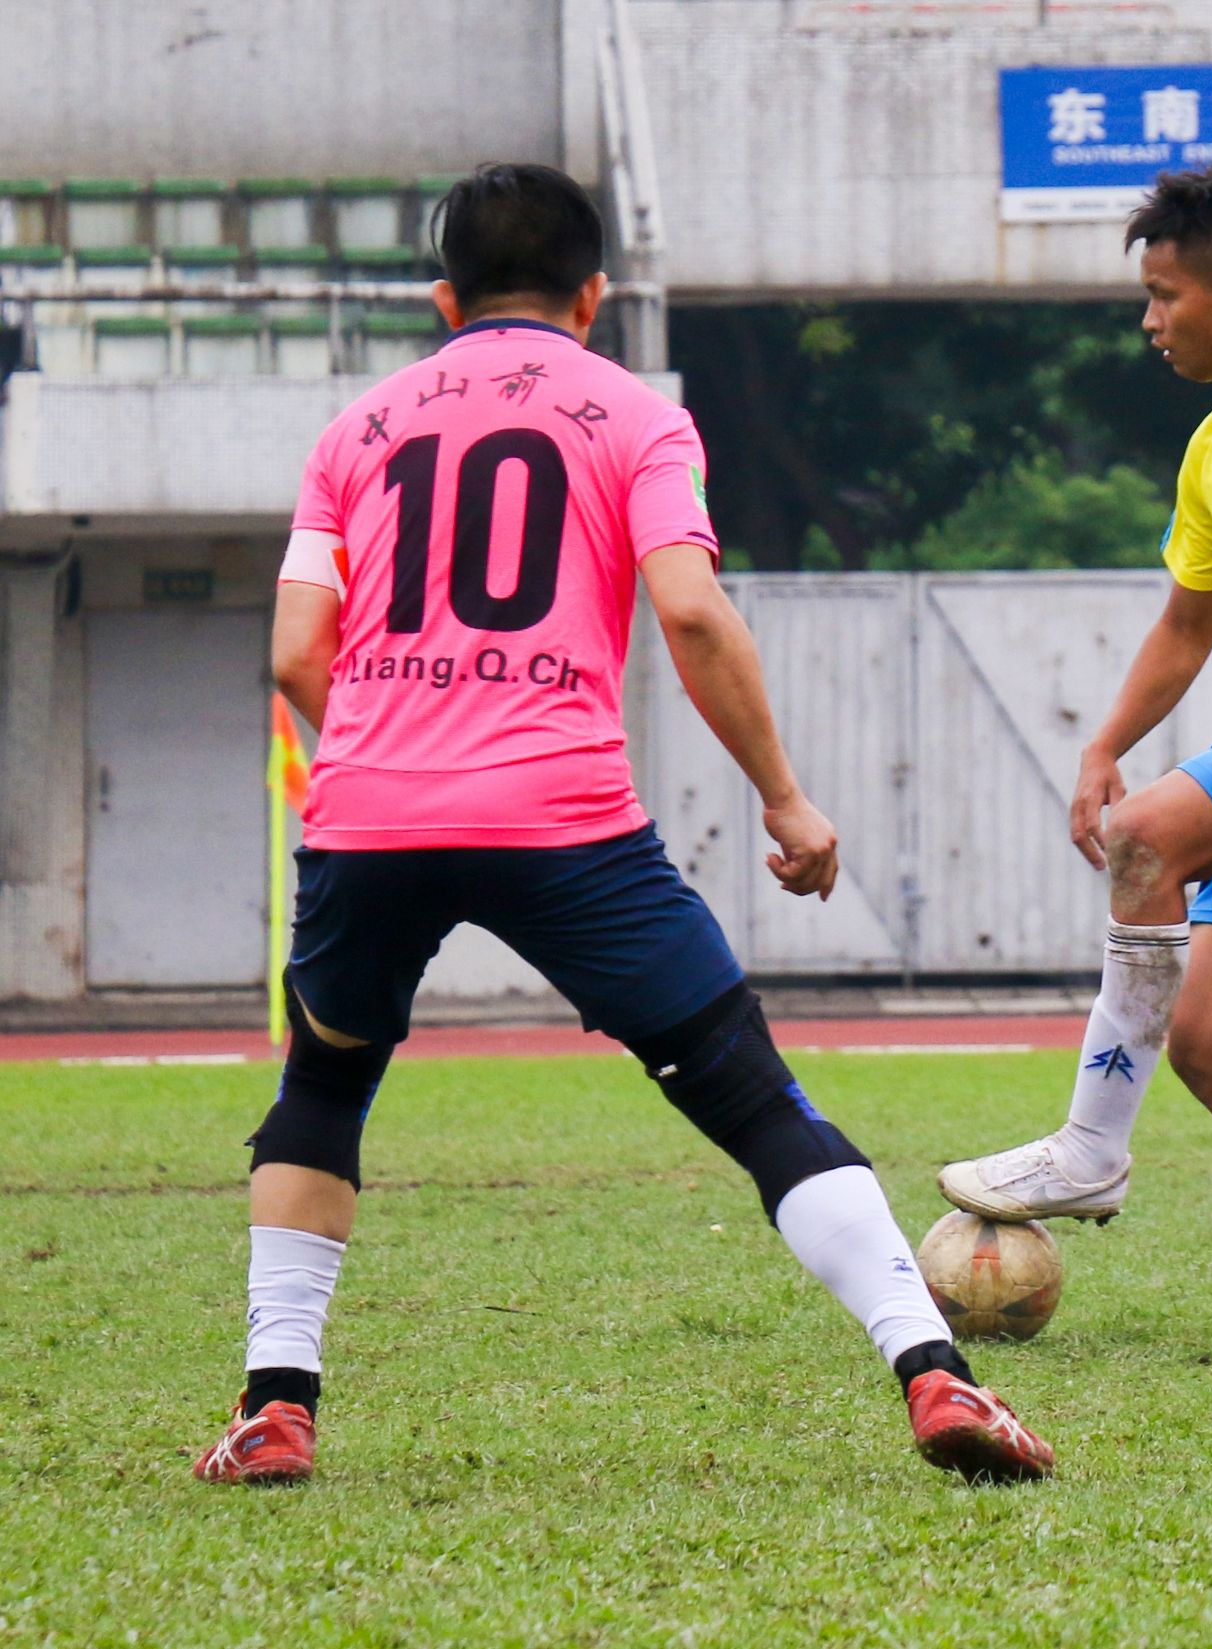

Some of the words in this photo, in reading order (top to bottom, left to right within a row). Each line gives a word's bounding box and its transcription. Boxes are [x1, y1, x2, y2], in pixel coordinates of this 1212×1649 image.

[360, 363, 609, 445] 中山前卫
[383, 427, 569, 634] 10
[350, 648, 581, 692] Liang.Q.Ch
